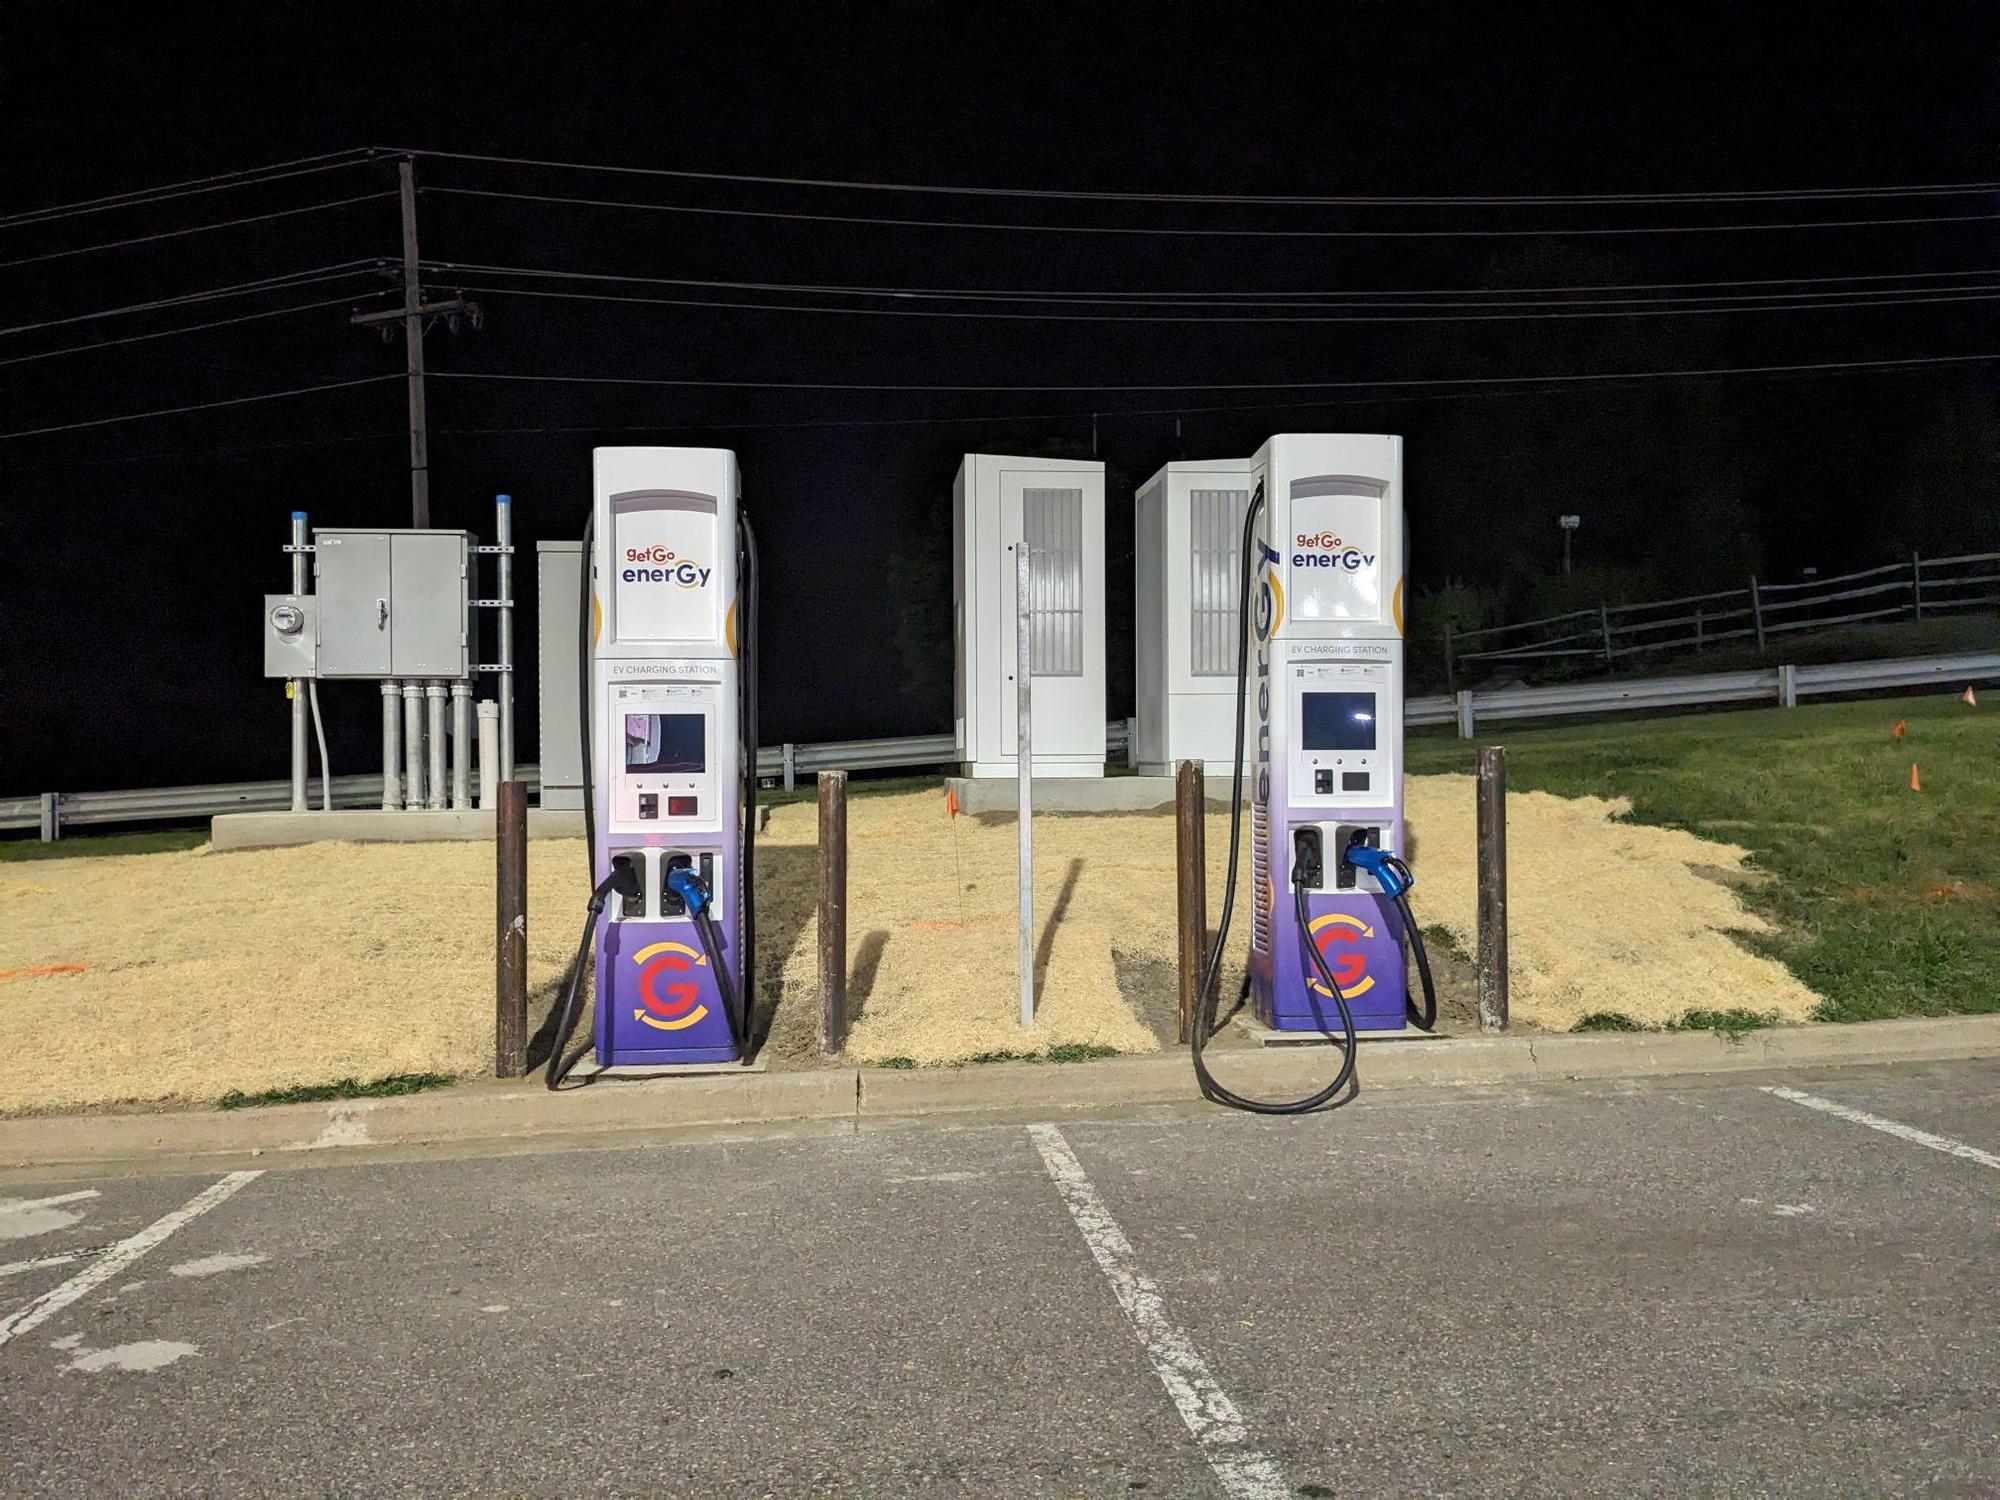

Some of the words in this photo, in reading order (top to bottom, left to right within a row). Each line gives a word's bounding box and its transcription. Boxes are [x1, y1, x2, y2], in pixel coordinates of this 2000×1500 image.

[1296, 533, 1342, 548] getGo
[626, 548, 675, 563] getGo
[622, 563, 711, 588] enerGy
[1291, 645, 1303, 654] EV
[1304, 645, 1351, 654] CHARGING
[1352, 645, 1388, 654] STATION
[613, 665, 624, 674] EV
[626, 665, 676, 674] CHARGING
[678, 665, 717, 674] STATION
[1312, 927, 1367, 985] G
[639, 955, 698, 1016] G
